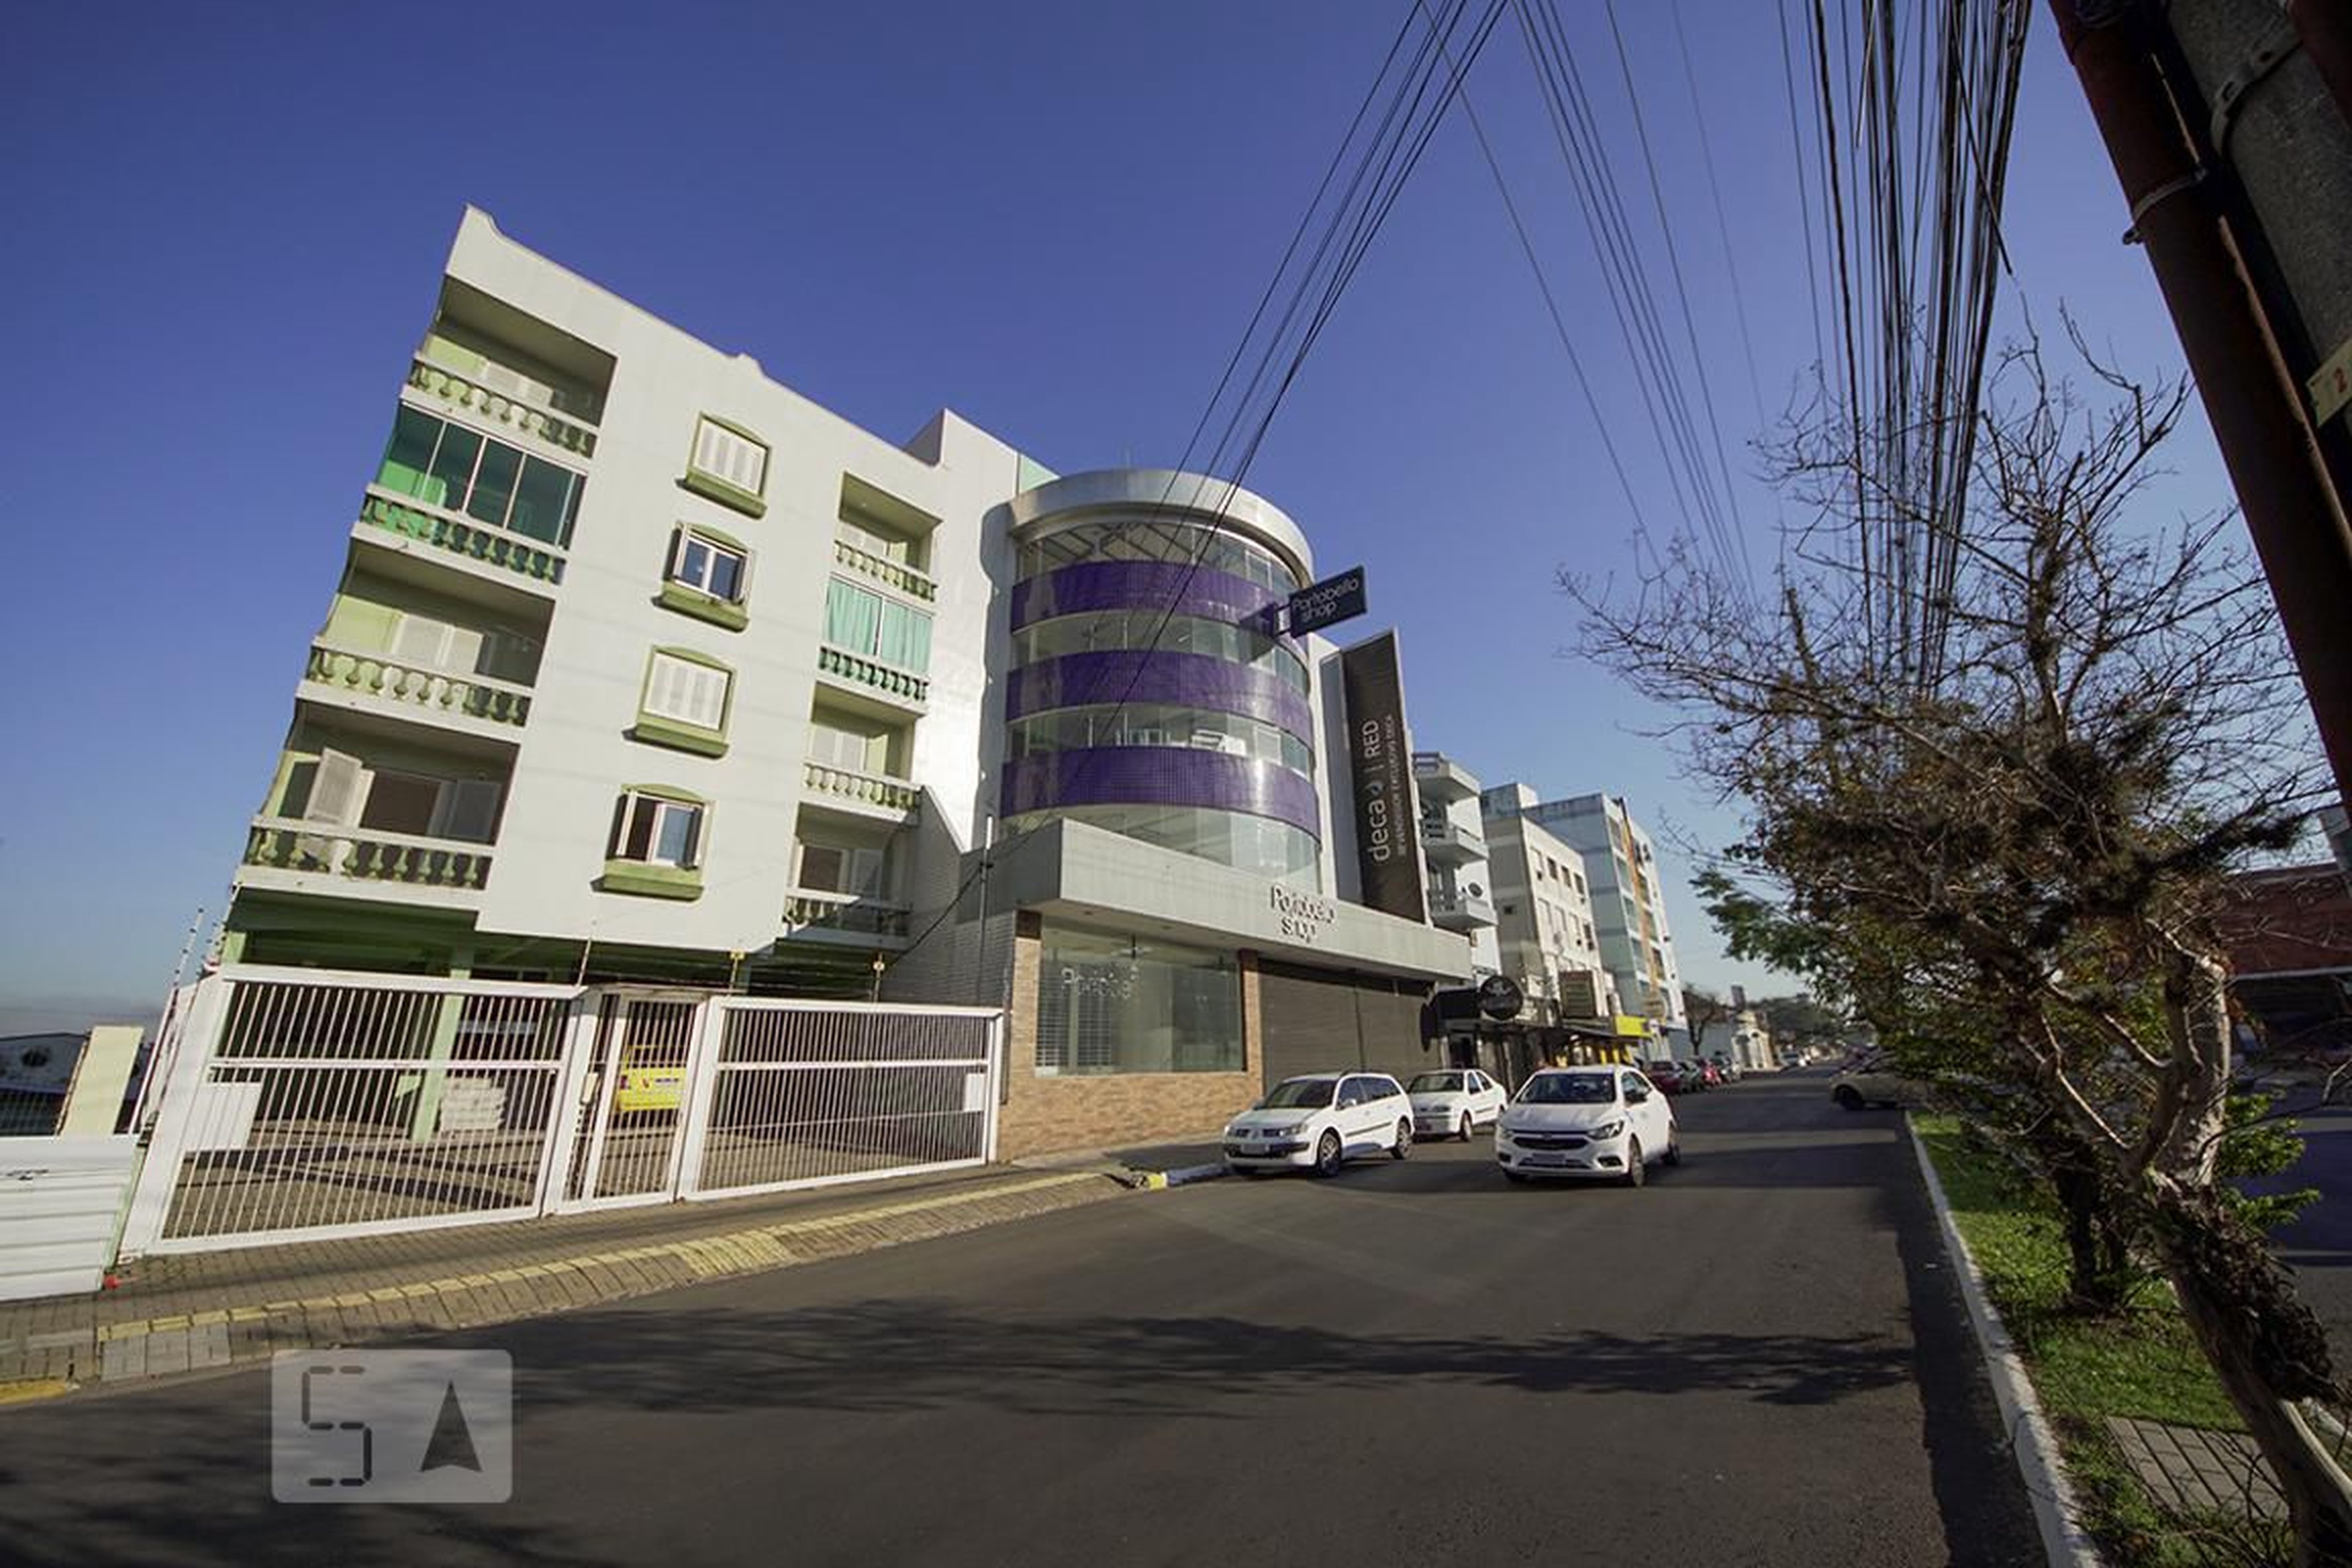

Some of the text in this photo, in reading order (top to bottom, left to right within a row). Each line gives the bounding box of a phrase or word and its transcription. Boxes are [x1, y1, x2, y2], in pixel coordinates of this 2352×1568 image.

[1293, 578, 1359, 610] Portobello
[1302, 601, 1336, 623] shop
[1362, 720, 1390, 861] deca RED
